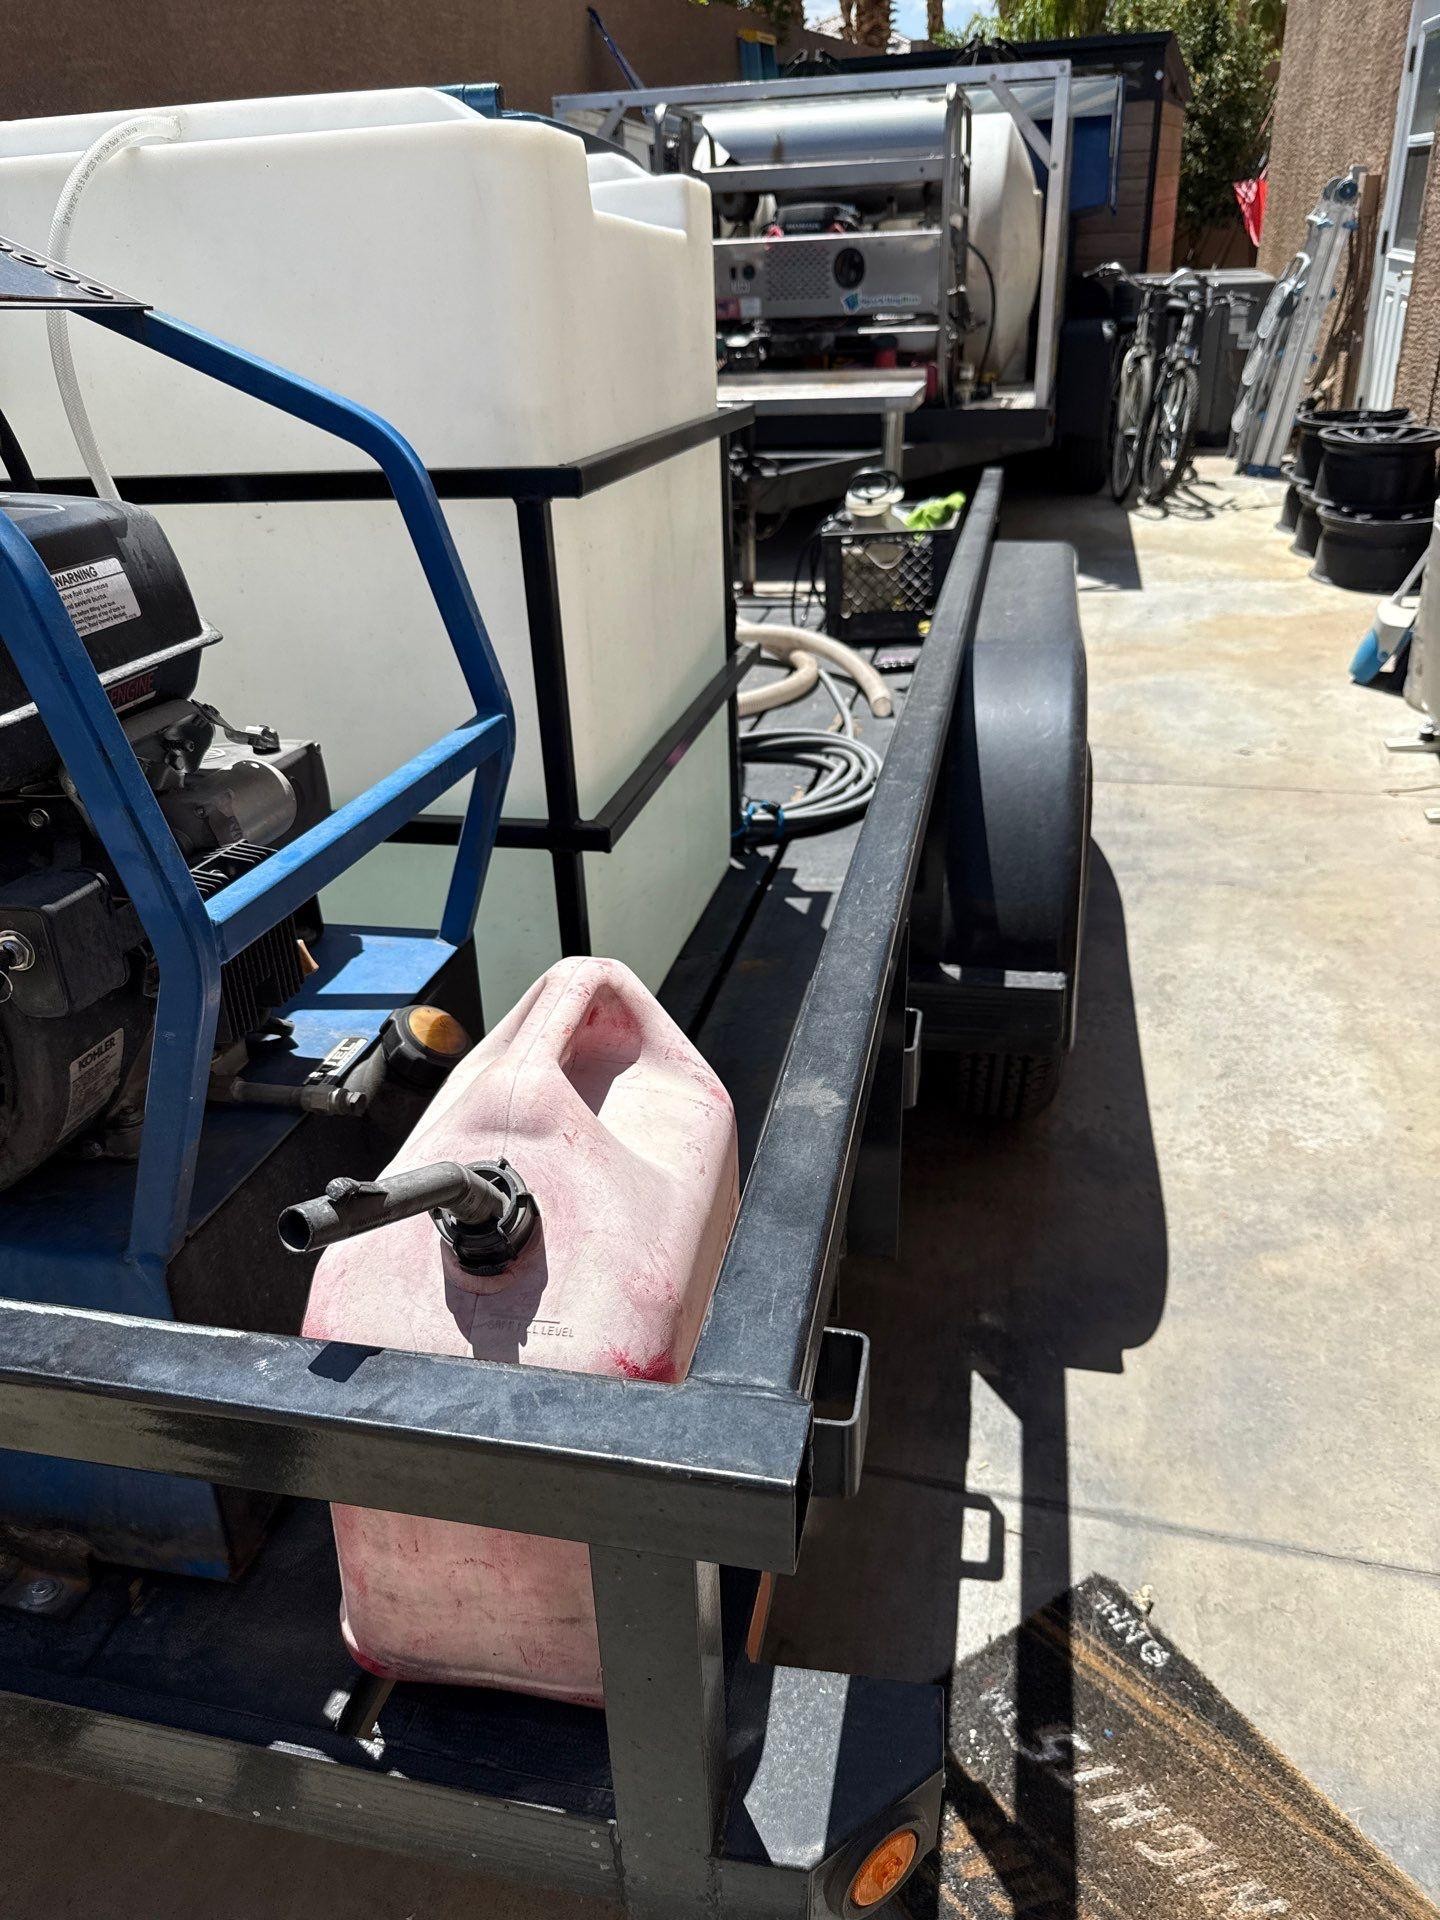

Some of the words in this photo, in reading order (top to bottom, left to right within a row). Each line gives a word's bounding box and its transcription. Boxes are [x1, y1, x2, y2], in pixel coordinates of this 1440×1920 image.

[54, 565, 98, 588] WARNING
[78, 1037, 116, 1071] KOHLER
[541, 1325, 574, 1338] LEVEL
